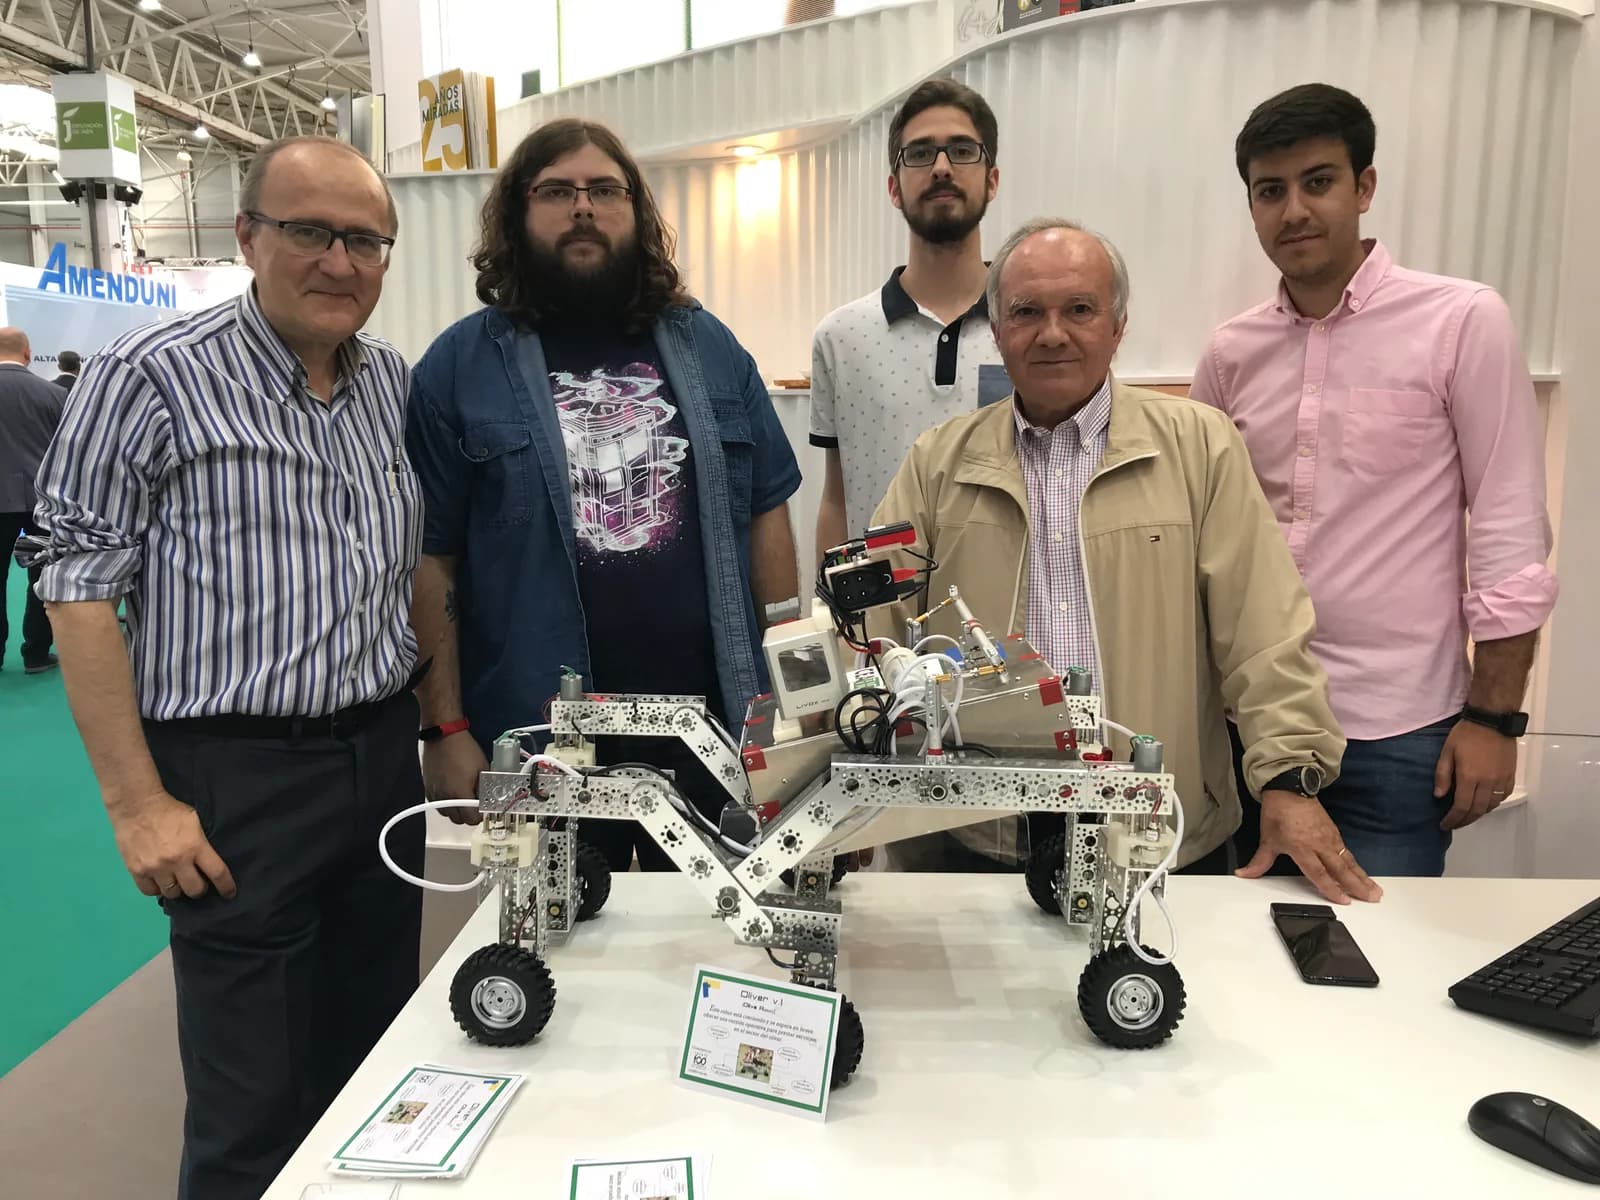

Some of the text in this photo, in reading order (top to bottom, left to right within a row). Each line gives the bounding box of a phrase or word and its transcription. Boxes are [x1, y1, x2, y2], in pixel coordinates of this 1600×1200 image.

[434, 85, 459, 105] AÑOS
[422, 100, 460, 122] MIRADAS
[37, 242, 176, 309] AMENDUNI
[740, 989, 768, 1001] Oliver
